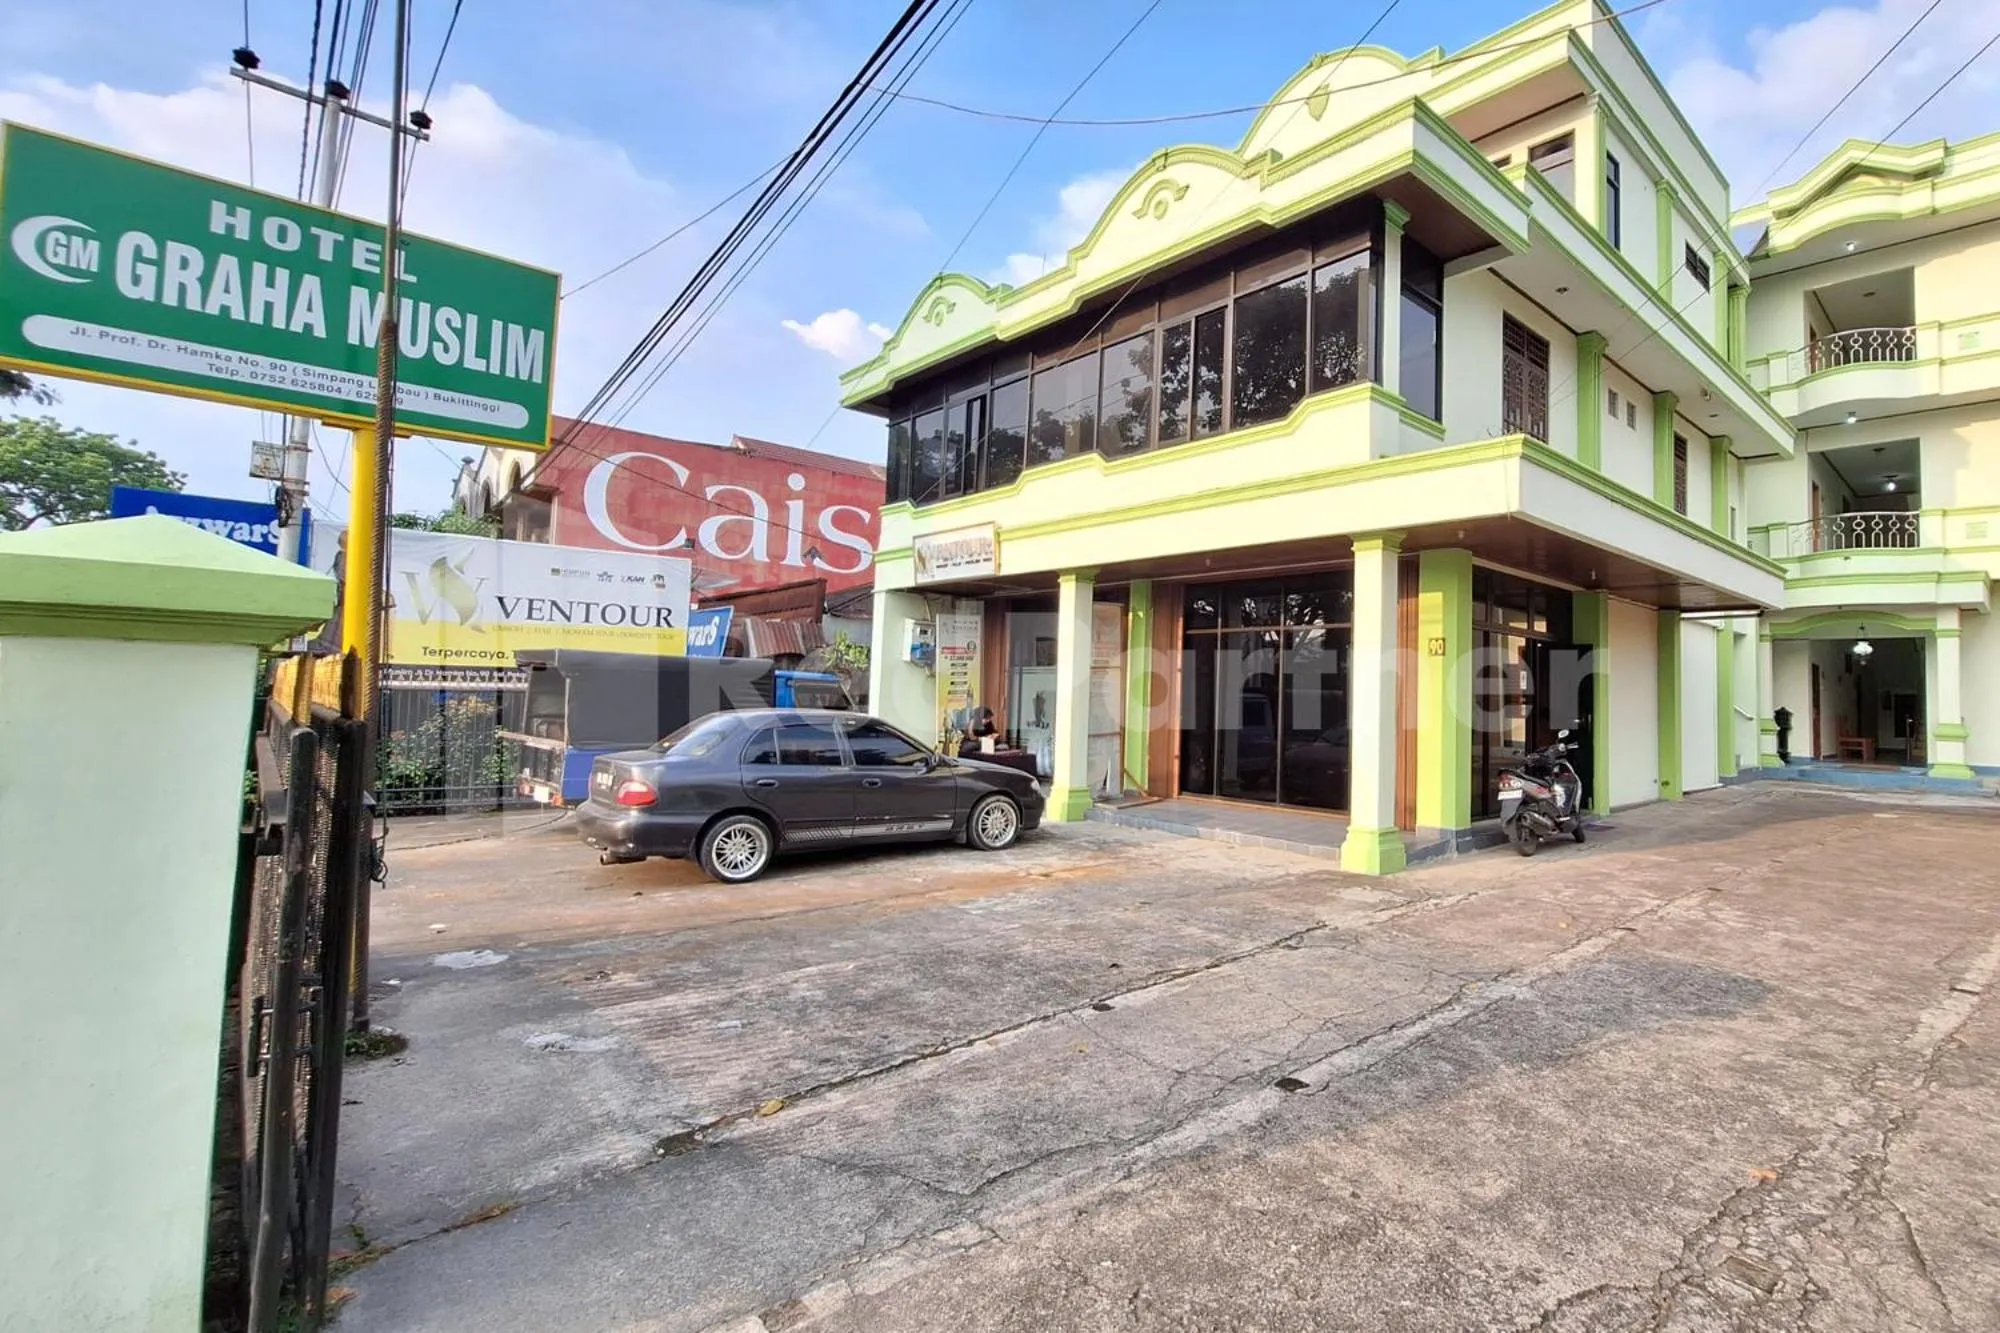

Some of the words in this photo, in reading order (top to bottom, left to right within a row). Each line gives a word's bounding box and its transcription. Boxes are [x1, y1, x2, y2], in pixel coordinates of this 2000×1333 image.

[45, 230, 100, 273] GM
[209, 200, 418, 283] HOTEL
[114, 231, 327, 339] GRAHA
[347, 285, 545, 384] MUSLIM
[70, 326, 91, 338] Jl.
[98, 330, 142, 346] Prof.
[150, 338, 170, 352] Dr.
[177, 344, 233, 363] Hamka
[238, 355, 265, 369] No.
[269, 361, 287, 373] 90
[302, 367, 364, 389] Simpang
[368, 378, 421, 398] Lbau
[433, 392, 501, 414] Bukittinggi
[207, 362, 246, 379] Telp.
[250, 370, 286, 384] 0752
[290, 378, 343, 396] 625804
[494, 595, 675, 629] VENTOUR
[1430, 639, 1444, 654] 90
